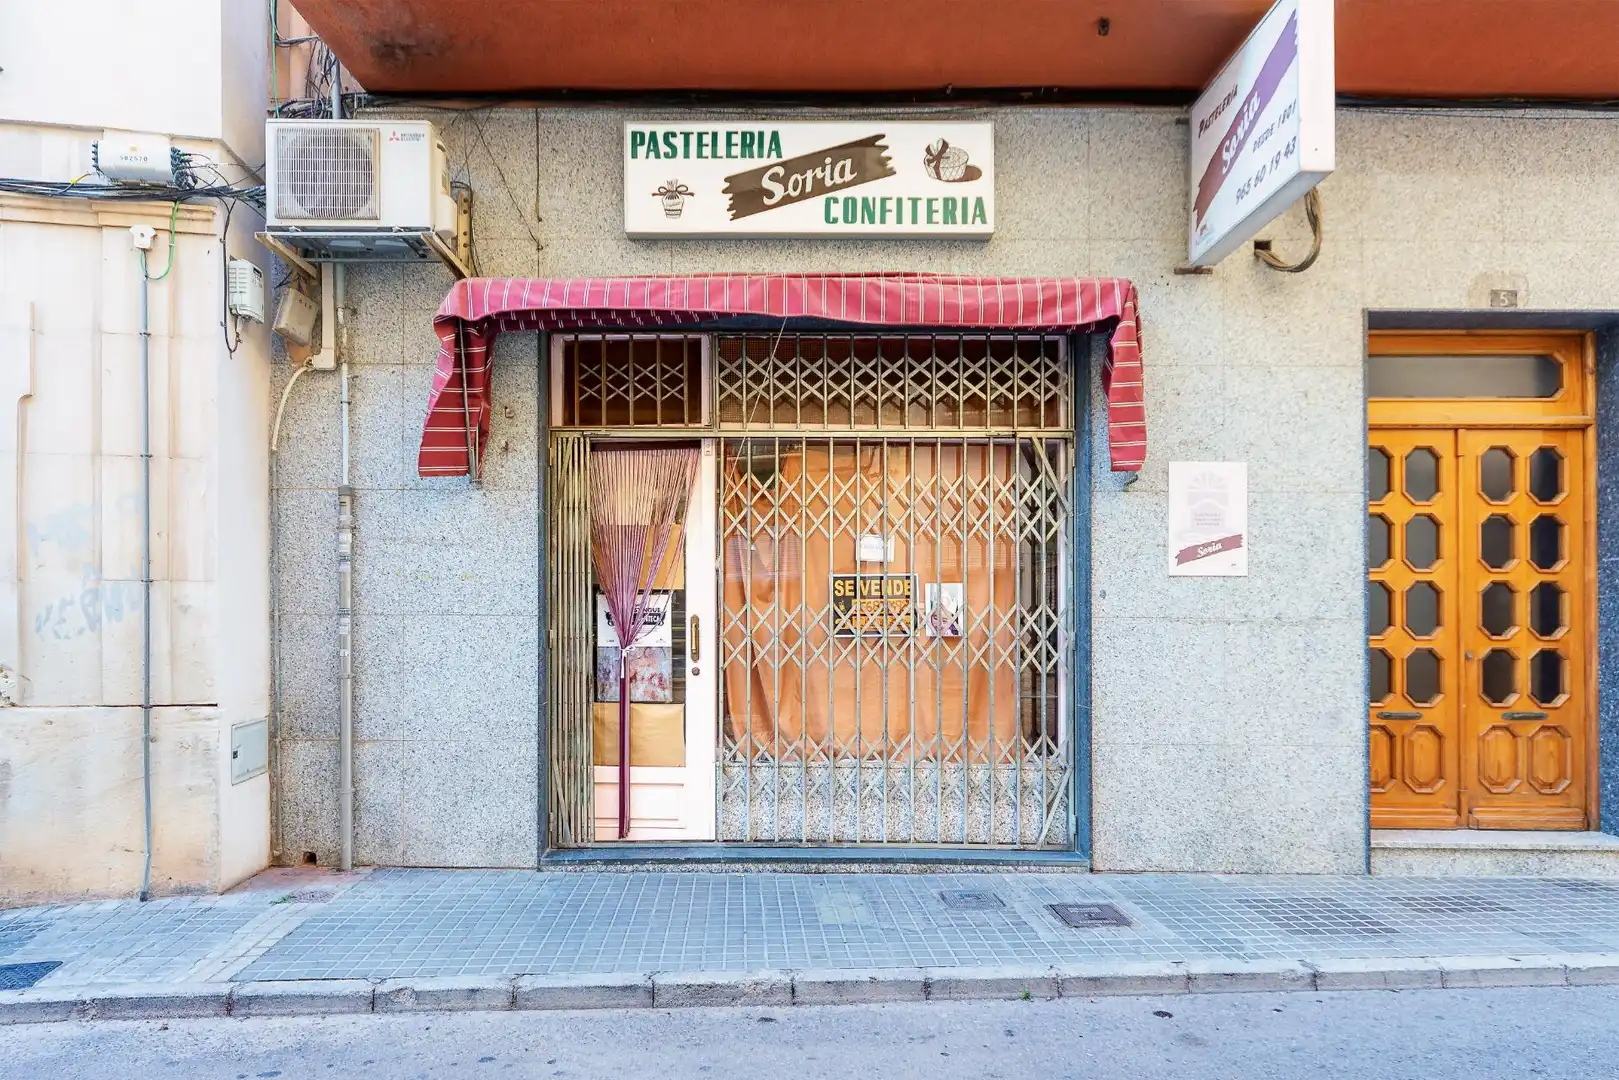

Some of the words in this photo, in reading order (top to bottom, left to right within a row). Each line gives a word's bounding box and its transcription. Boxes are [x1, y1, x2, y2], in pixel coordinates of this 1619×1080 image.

[630, 130, 783, 160] PASTELERIA
[1221, 91, 1261, 174] Soria
[1252, 122, 1275, 153] DESDE
[1269, 149, 1282, 177] 19
[761, 155, 857, 207] Soria
[824, 196, 988, 225] CONFITERIA
[1499, 291, 1509, 306] 5
[1196, 541, 1223, 558] Soria
[834, 579, 855, 597] SE
[859, 579, 912, 597] VENDE
